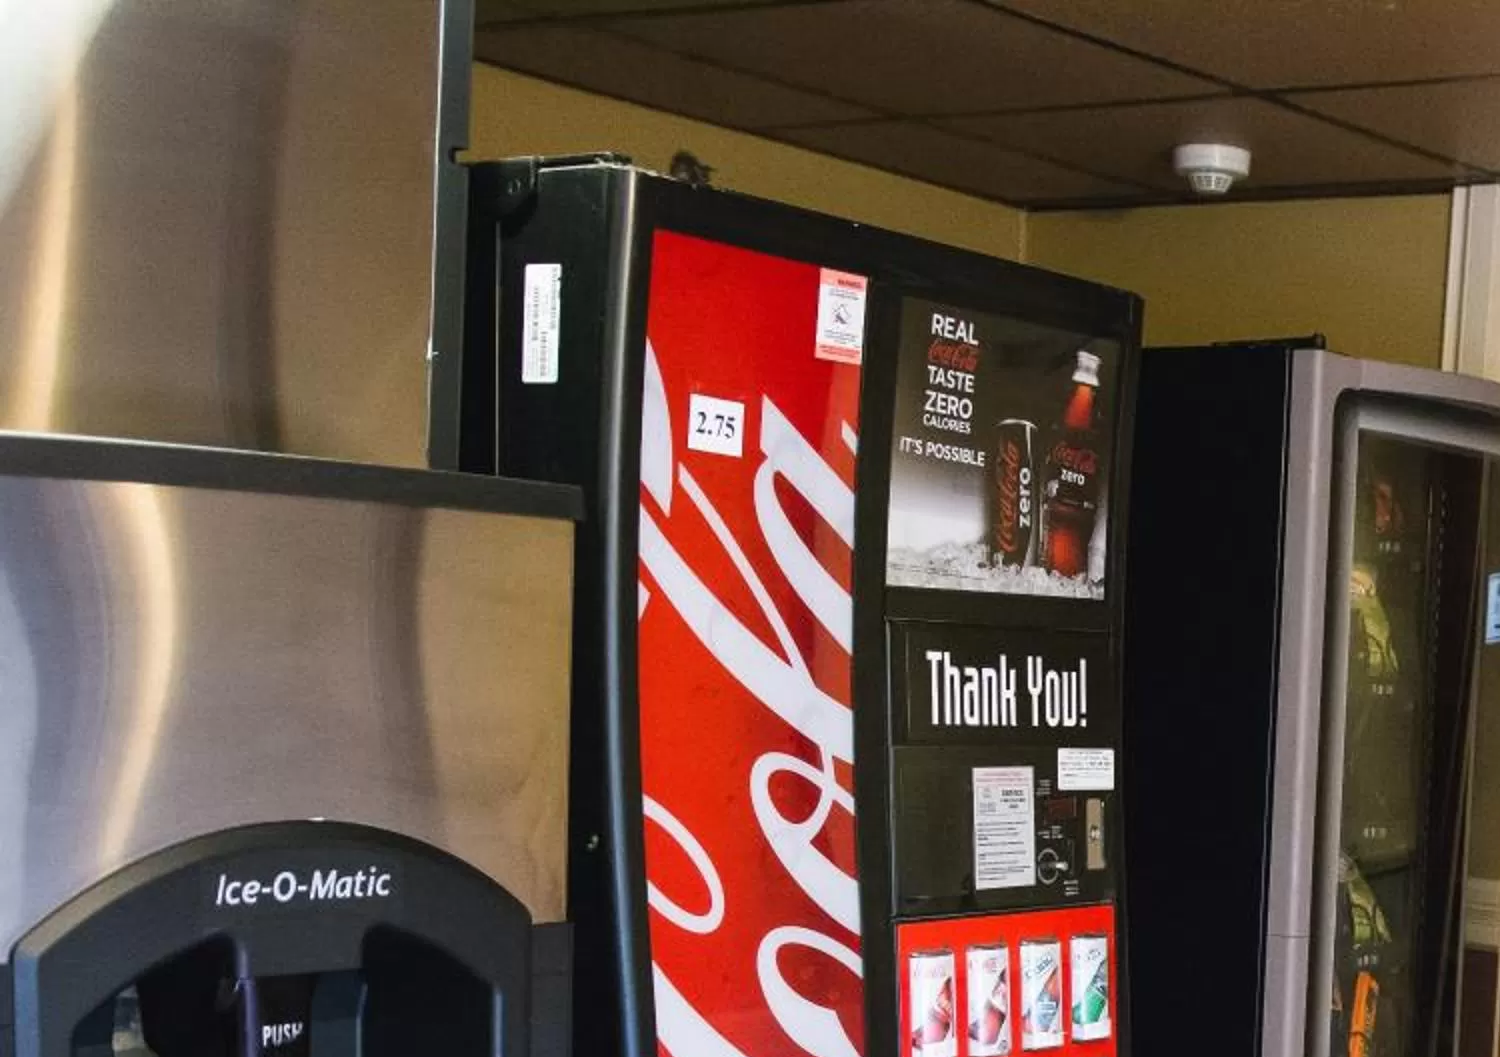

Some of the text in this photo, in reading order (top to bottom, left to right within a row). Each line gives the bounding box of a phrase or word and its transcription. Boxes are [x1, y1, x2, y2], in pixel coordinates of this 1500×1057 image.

[931, 312, 979, 346] REAL
[927, 364, 975, 393] TASTE
[924, 389, 973, 419] ZERO
[696, 411, 736, 439] 2.75
[923, 413, 971, 435] CALORIES
[899, 435, 985, 467] IT'S POSSIBLE
[1061, 468, 1085, 486] zero
[1019, 467, 1031, 528] zero
[926, 650, 1087, 728] Thank You!
[215, 865, 392, 906] Ice-O-Matic
[262, 1022, 303, 1048] PUSH
